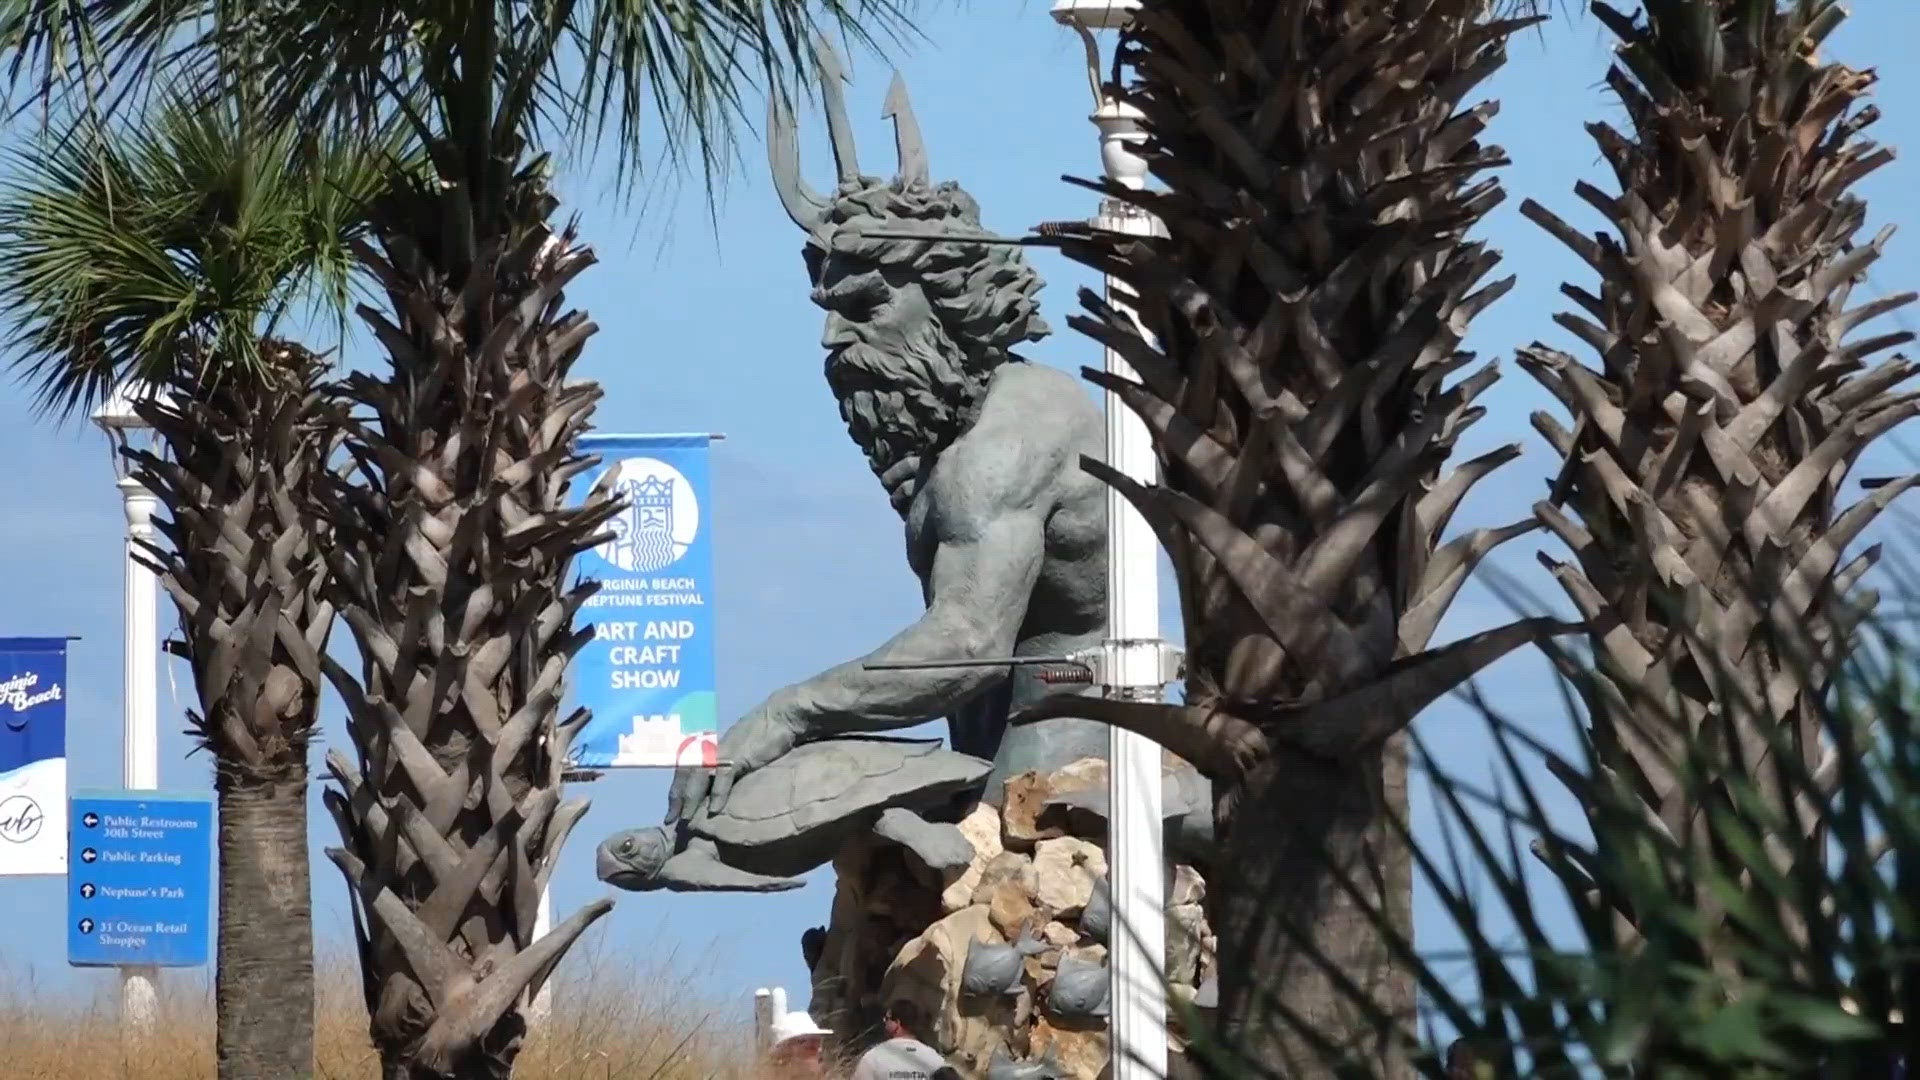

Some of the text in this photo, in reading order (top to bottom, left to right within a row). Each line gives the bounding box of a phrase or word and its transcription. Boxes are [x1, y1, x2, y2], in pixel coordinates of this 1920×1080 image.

[602, 578, 695, 590] RGINIA BEACH
[646, 594, 704, 605] FESTIVAL
[594, 621, 694, 640] ART AND
[609, 645, 681, 664] CRAFT
[611, 669, 680, 689] SHOW
[9, 683, 61, 711] Beach
[103, 815, 198, 829] Public Restrooms
[103, 827, 165, 839] 30th Street
[102, 851, 181, 866] Public Parking
[101, 886, 184, 899] Neptune's Park
[100, 922, 187, 934] 31 Ocean Retail
[100, 934, 147, 948] Shoppes
